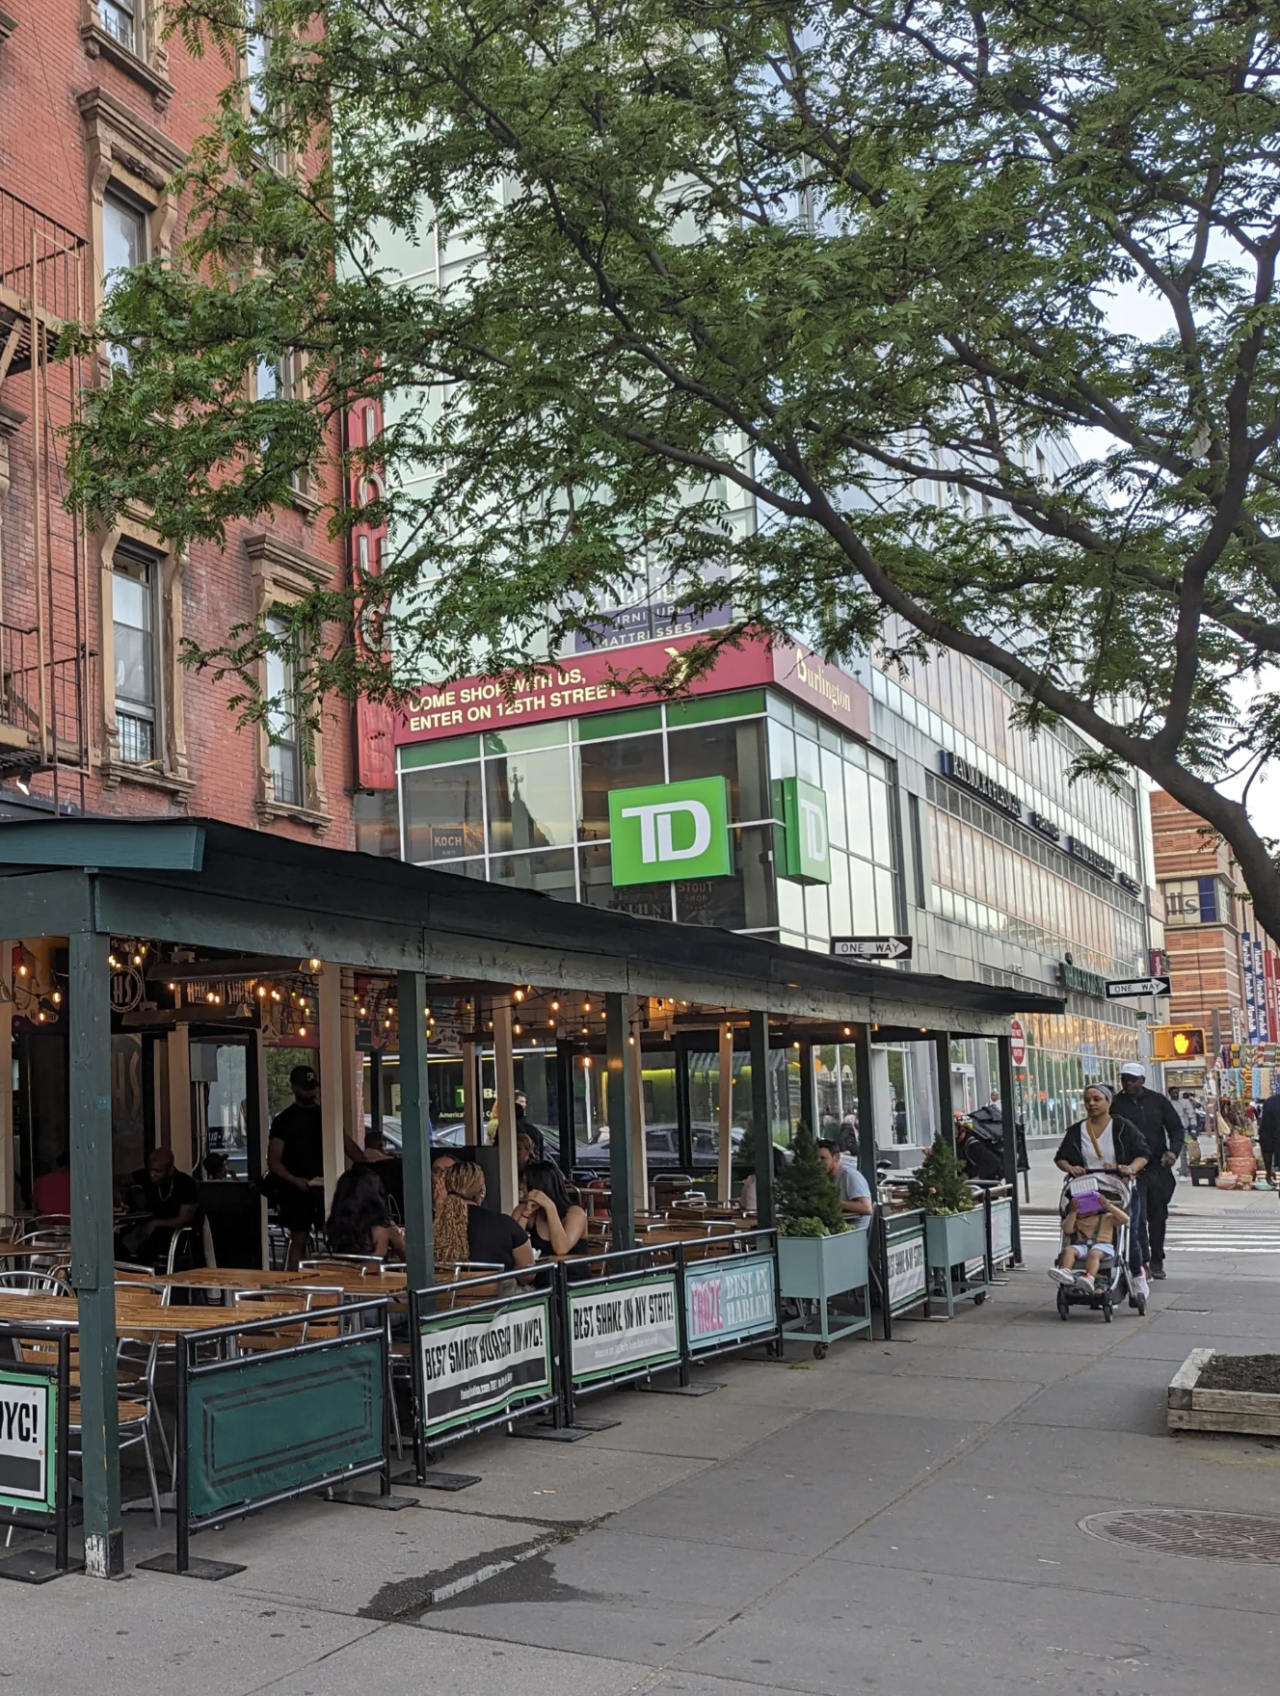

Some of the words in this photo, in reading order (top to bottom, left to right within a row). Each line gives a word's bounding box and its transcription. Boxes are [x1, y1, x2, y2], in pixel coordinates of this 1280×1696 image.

[598, 622, 693, 649] MATTRSSES
[796, 647, 852, 713] Burlington
[409, 691, 457, 713] COME
[410, 711, 464, 733] ENTER
[466, 705, 492, 722] ON
[496, 695, 547, 717] 125TH
[434, 836, 463, 847] KOCH
[621, 799, 712, 864] TD
[800, 797, 827, 863] TD
[677, 881, 714, 893] STOUT
[841, 943, 865, 953] ONE
[875, 943, 900, 953] WAY
[1114, 984, 1134, 993] ONE
[1141, 982, 1161, 992] WAY
[725, 1271, 754, 1299] BEST
[573, 1305, 594, 1341] BEST
[595, 1299, 623, 1337] SHAKE
[635, 1295, 647, 1328] NY
[648, 1290, 674, 1324] STATE!
[726, 1293, 771, 1326] HARLEM
[424, 1343, 448, 1381] BEST
[523, 1317, 544, 1350] NYC!
